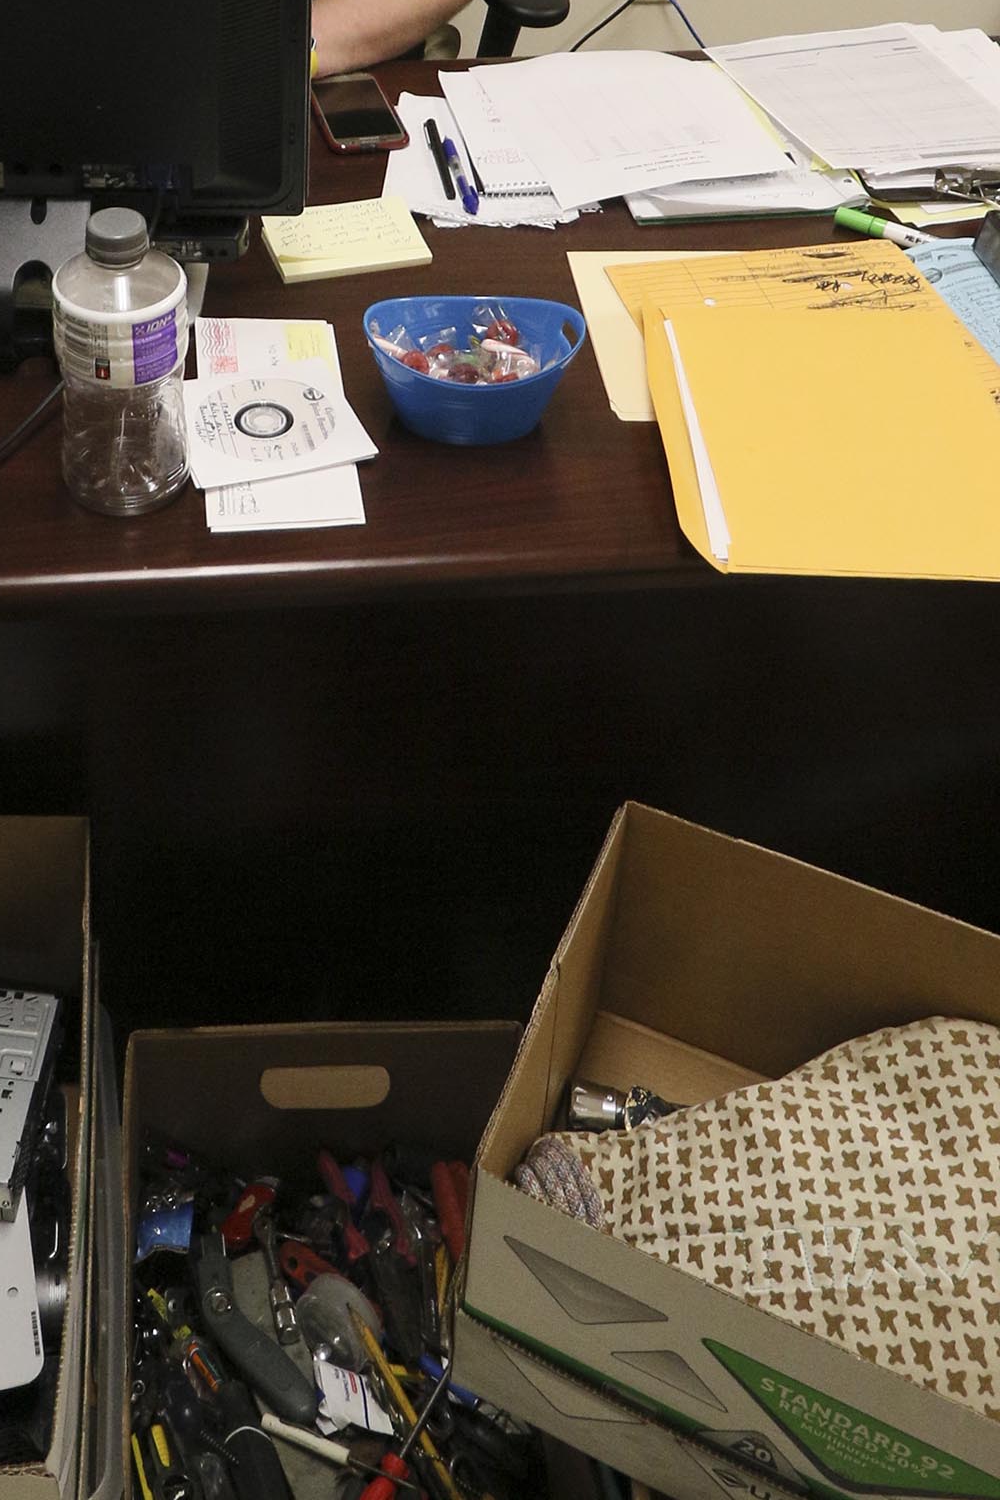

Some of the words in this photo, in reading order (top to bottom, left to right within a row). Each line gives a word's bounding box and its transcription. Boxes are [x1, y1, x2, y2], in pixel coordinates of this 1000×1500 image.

[740, 1439, 772, 1463] 20
[760, 1376, 912, 1458] STANDARD
[921, 1455, 956, 1479] 92
[779, 1400, 879, 1454] RECYCLED
[887, 1451, 929, 1479] 30%
